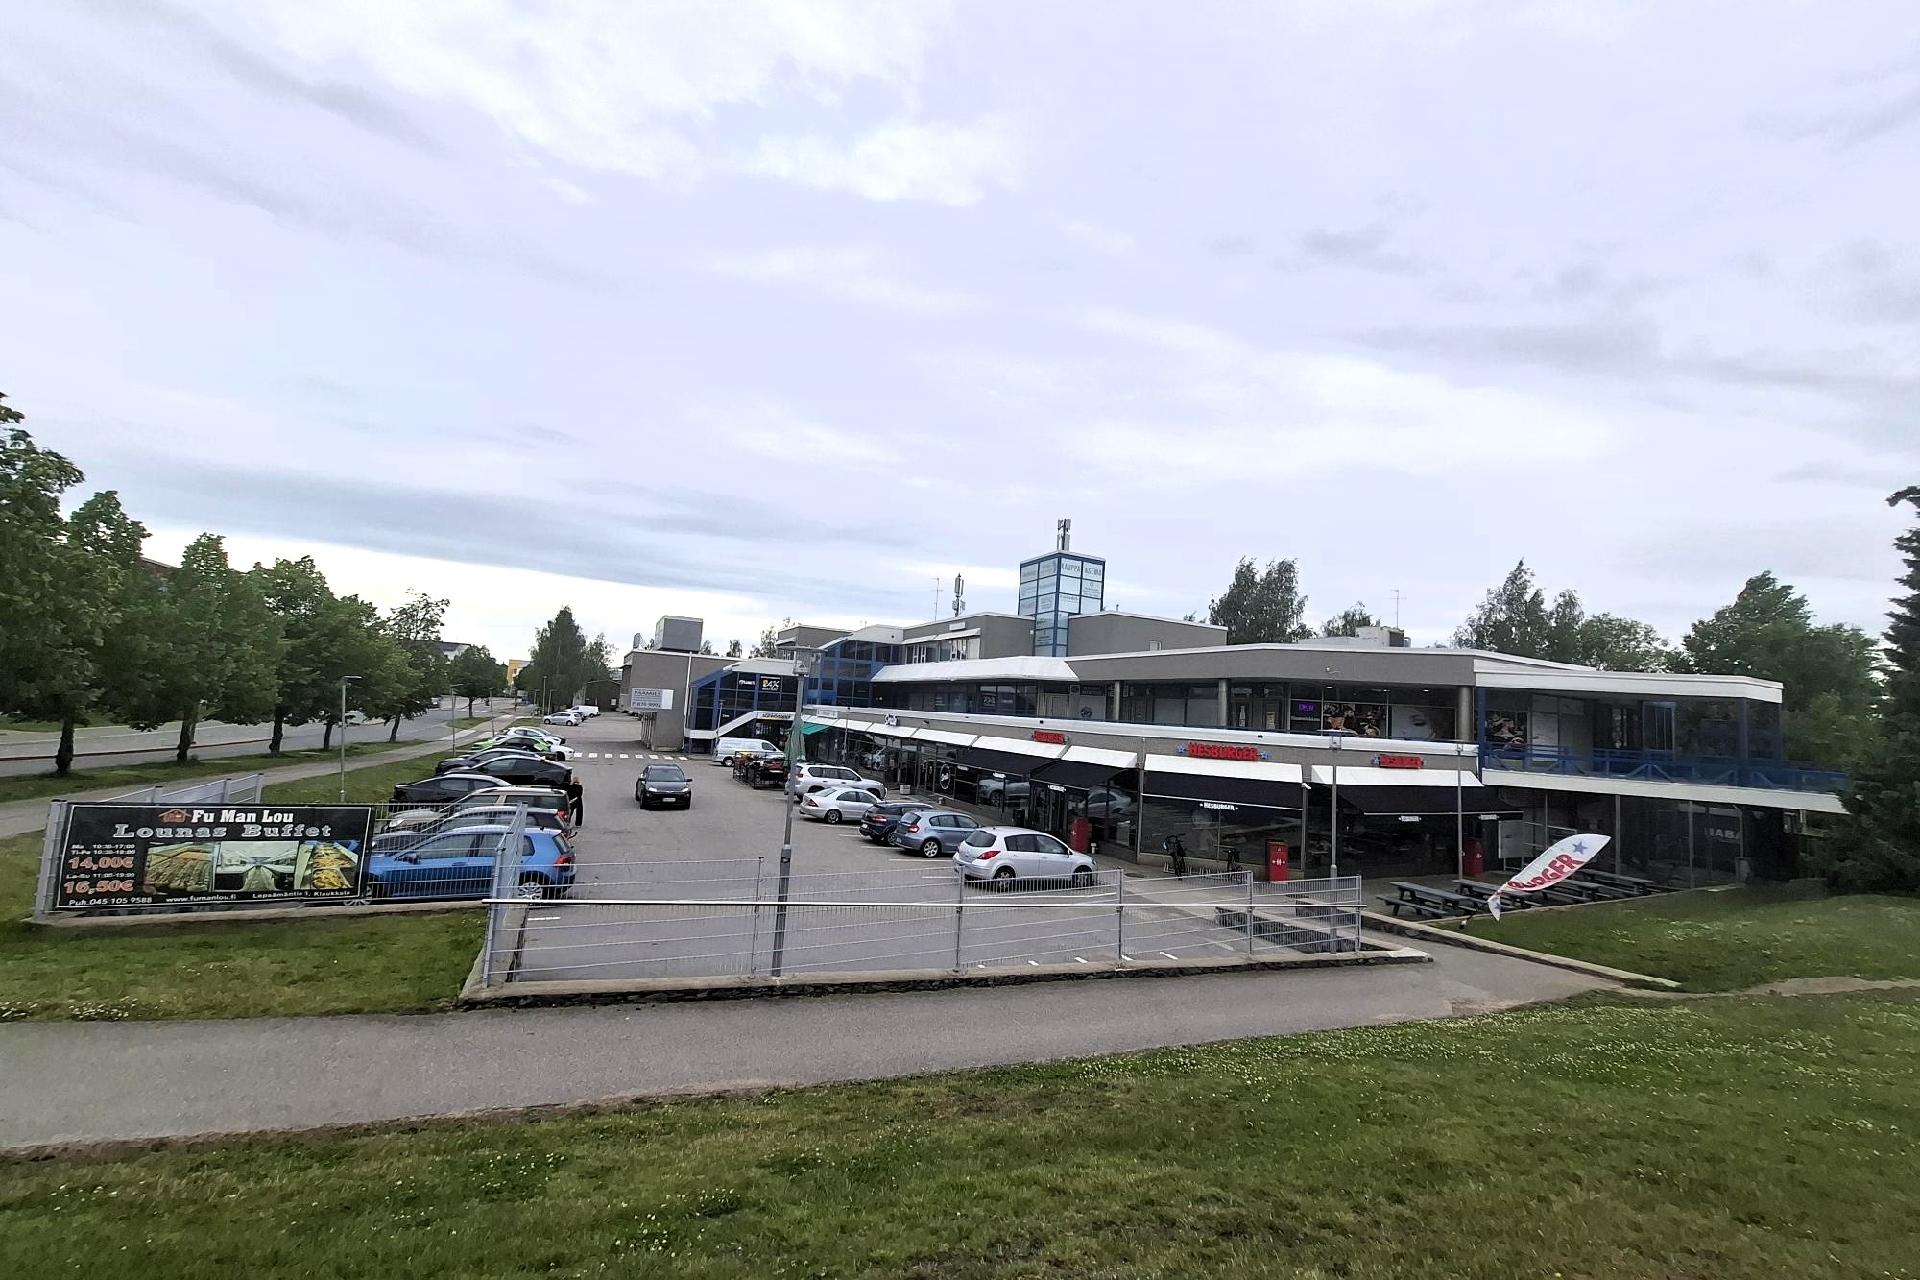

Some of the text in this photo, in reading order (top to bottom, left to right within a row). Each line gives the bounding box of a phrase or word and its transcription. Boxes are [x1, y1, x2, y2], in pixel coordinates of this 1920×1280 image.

[1188, 741, 1258, 761] HESBURGER
[191, 810, 294, 823] Fu Man Lou
[112, 823, 332, 838] Lounas Buffet
[68, 856, 134, 871] 14,00€
[63, 880, 134, 895] 16,50€
